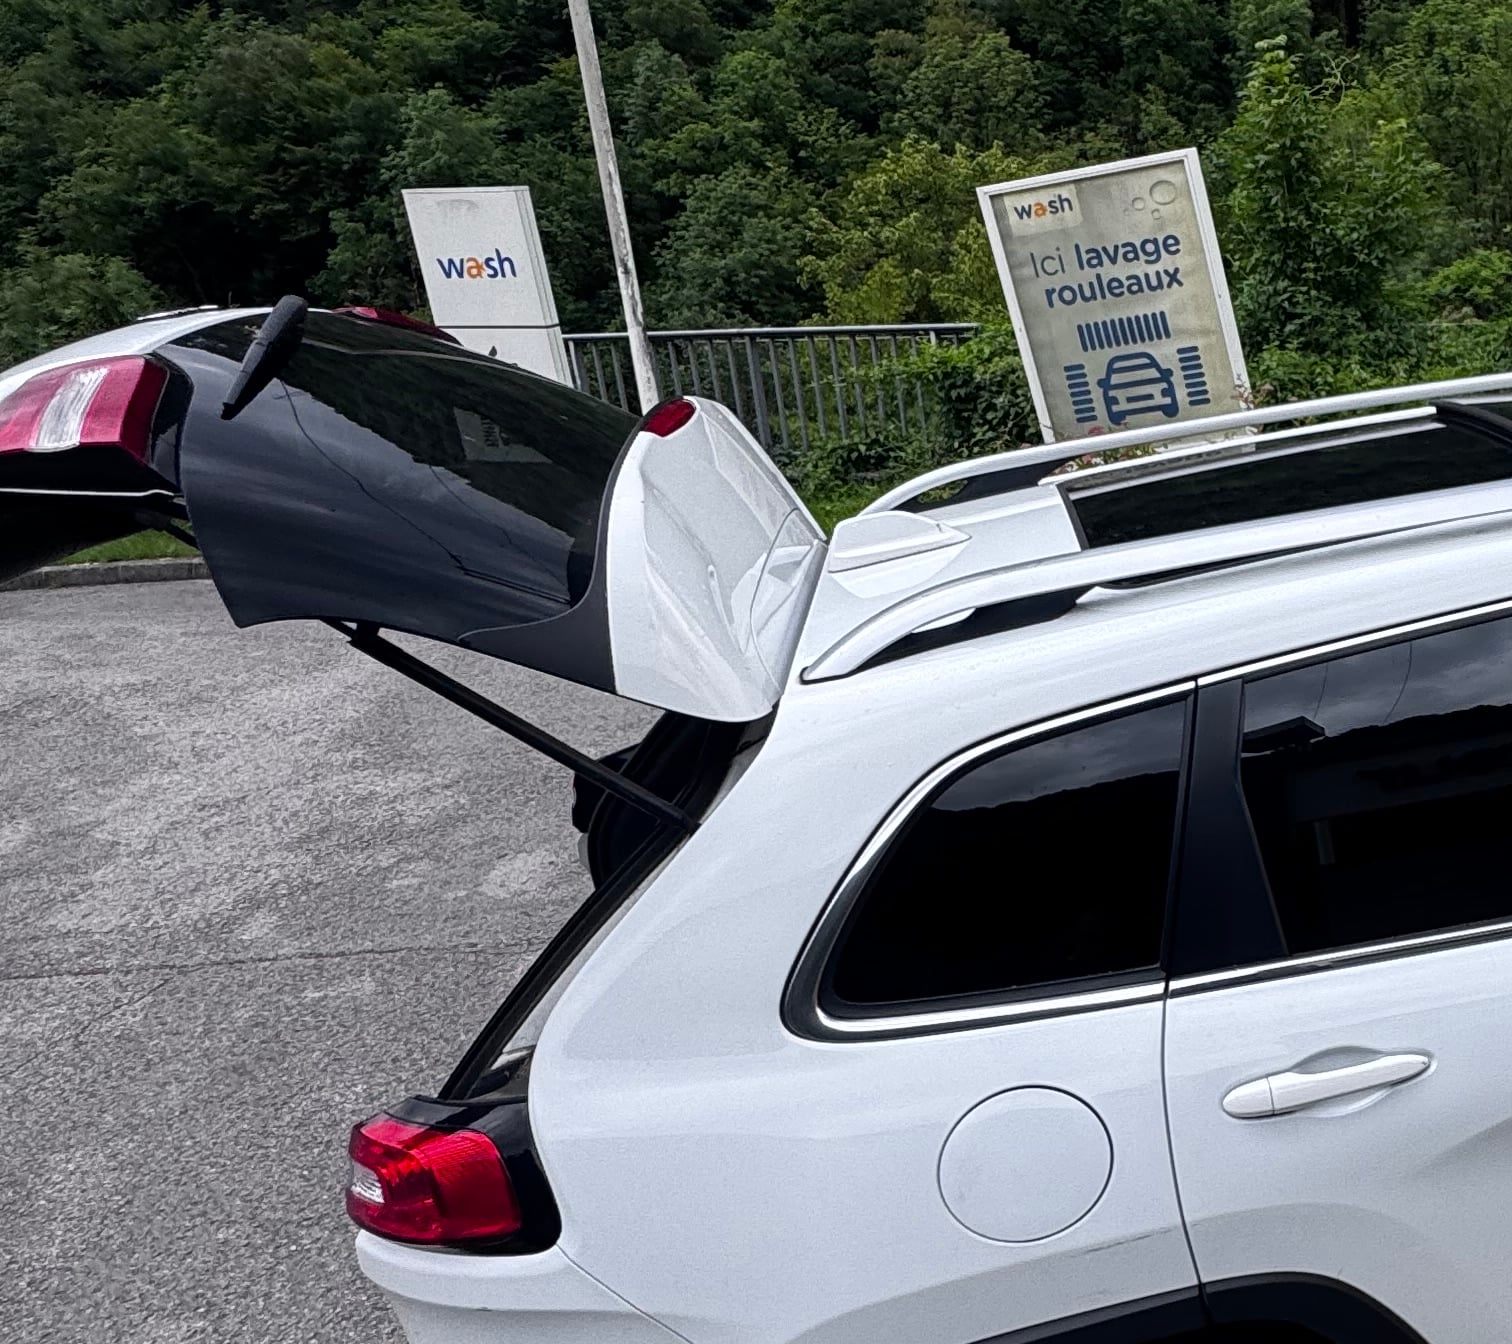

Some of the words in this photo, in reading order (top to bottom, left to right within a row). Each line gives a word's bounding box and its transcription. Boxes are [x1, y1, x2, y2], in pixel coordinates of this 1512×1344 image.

[1014, 194, 1073, 220] wash
[436, 247, 517, 279] wash
[1029, 246, 1066, 278] Ici
[1074, 233, 1181, 270] lavage
[1044, 267, 1184, 308] rouleaux
